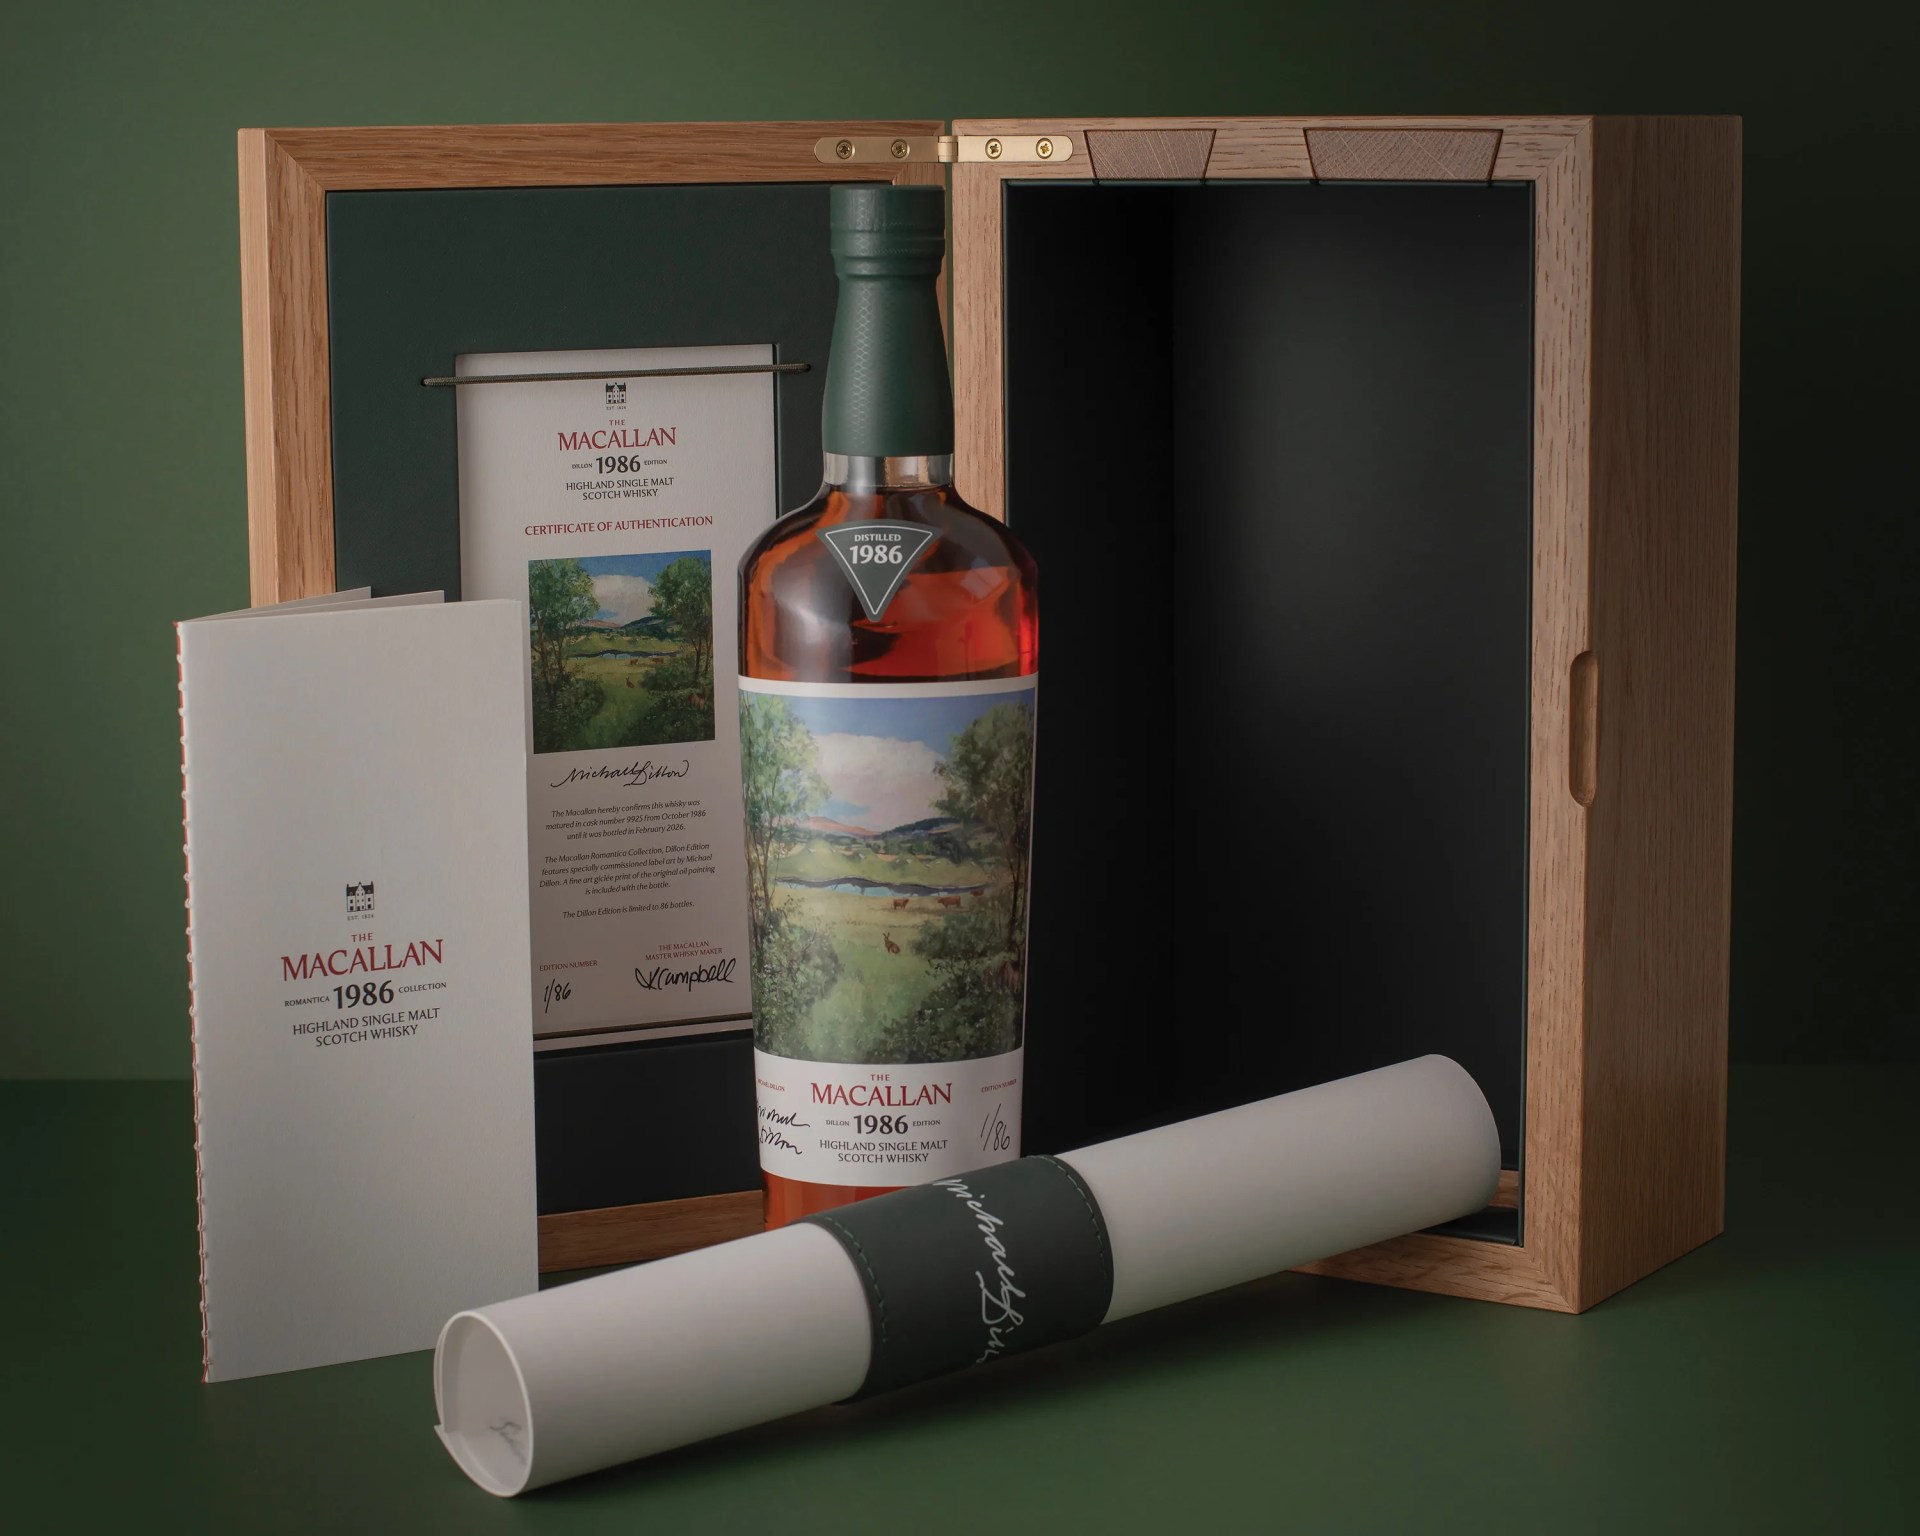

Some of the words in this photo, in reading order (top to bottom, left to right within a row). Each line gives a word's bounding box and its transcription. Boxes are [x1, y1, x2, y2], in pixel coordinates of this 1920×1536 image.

[558, 427, 677, 451] MACALLAN
[596, 455, 641, 474] 1986
[566, 480, 615, 490] HIGHLAND
[617, 479, 649, 488] SINGLE
[651, 477, 674, 486] MALT
[583, 491, 621, 500] SCOTCH
[623, 489, 659, 498] WHISKY
[525, 523, 595, 535] CERTIFICATE
[597, 522, 613, 531] OF
[614, 516, 713, 530] AUTHENTICATION
[854, 534, 901, 542] DISTILLED
[849, 545, 903, 564] 1986
[552, 809, 564, 818] The
[565, 807, 596, 817] Macallan
[598, 806, 620, 815] hereby
[621, 803, 650, 812] confirms
[651, 801, 663, 809] this
[665, 800, 686, 808] whisky
[545, 820, 574, 830] matured
[583, 818, 598, 826] cask
[599, 816, 625, 825] number
[626, 815, 643, 823] 9925
[644, 813, 661, 823] from
[662, 812, 689, 820] October
[691, 810, 706, 818] 1986
[566, 831, 582, 840] until
[603, 828, 627, 837] bottled
[636, 825, 666, 834] February
[667, 823, 685, 831] 2026.
[545, 856, 557, 864] The
[559, 853, 590, 863] Macallan
[591, 850, 627, 860] Romantica
[628, 847, 663, 857] Collection,
[665, 845, 685, 853] Dillon
[686, 843, 709, 851] Edition
[541, 867, 569, 876] features
[570, 864, 599, 874] specially
[600, 859, 647, 871] commissioned
[648, 858, 665, 866] label
[666, 857, 676, 865] art
[677, 856, 685, 865] by
[686, 854, 713, 863] Michael
[540, 878, 562, 888] Dillon.
[569, 876, 582, 885] fine
[583, 876, 593, 884] art
[615, 872, 631, 882] print
[632, 870, 640, 881] of
[641, 870, 652, 878] the
[653, 867, 678, 878] original
[679, 866, 687, 874] oil
[688, 865, 715, 875] painting
[585, 887, 591, 895] is
[592, 885, 620, 894] included
[621, 883, 636, 891] with
[637, 882, 648, 890] the
[649, 880, 670, 889] bottle.
[563, 911, 576, 919] The
[577, 909, 597, 918] Dillon
[598, 906, 621, 915] Edition
[628, 903, 651, 912] limited
[670, 900, 695, 908] bottles.
[352, 933, 374, 942] THE
[673, 940, 709, 950] MACALLAN
[281, 939, 443, 982] MACALLAN
[645, 953, 672, 961] MASTER
[673, 950, 699, 958] WHISKY
[700, 948, 723, 956] MAKER
[539, 963, 568, 972] EDITION
[570, 960, 598, 968] NUMBER
[284, 996, 330, 1007] ROMANTICA
[333, 980, 394, 1010] 1986
[398, 982, 447, 993] COLLECTION
[544, 979, 572, 1014] 1/86
[293, 1017, 359, 1035] HIGHLAND
[362, 1012, 405, 1027] SINGLE
[408, 1008, 440, 1020] MALT
[316, 1031, 367, 1047] SCOTCH
[370, 1024, 418, 1040] WHISKY
[811, 1082, 952, 1107] MACALLAN
[981, 1084, 1001, 1092] EDITION
[853, 1115, 909, 1134] 1986
[912, 1119, 941, 1127] EDITION
[980, 1103, 1010, 1151] 1/86
[820, 1140, 876, 1151] HIGHLAND
[879, 1141, 918, 1151] SINGLE
[920, 1140, 949, 1149] MALT
[838, 1153, 883, 1163] SCOTCH
[886, 1153, 929, 1162] WHISKY
